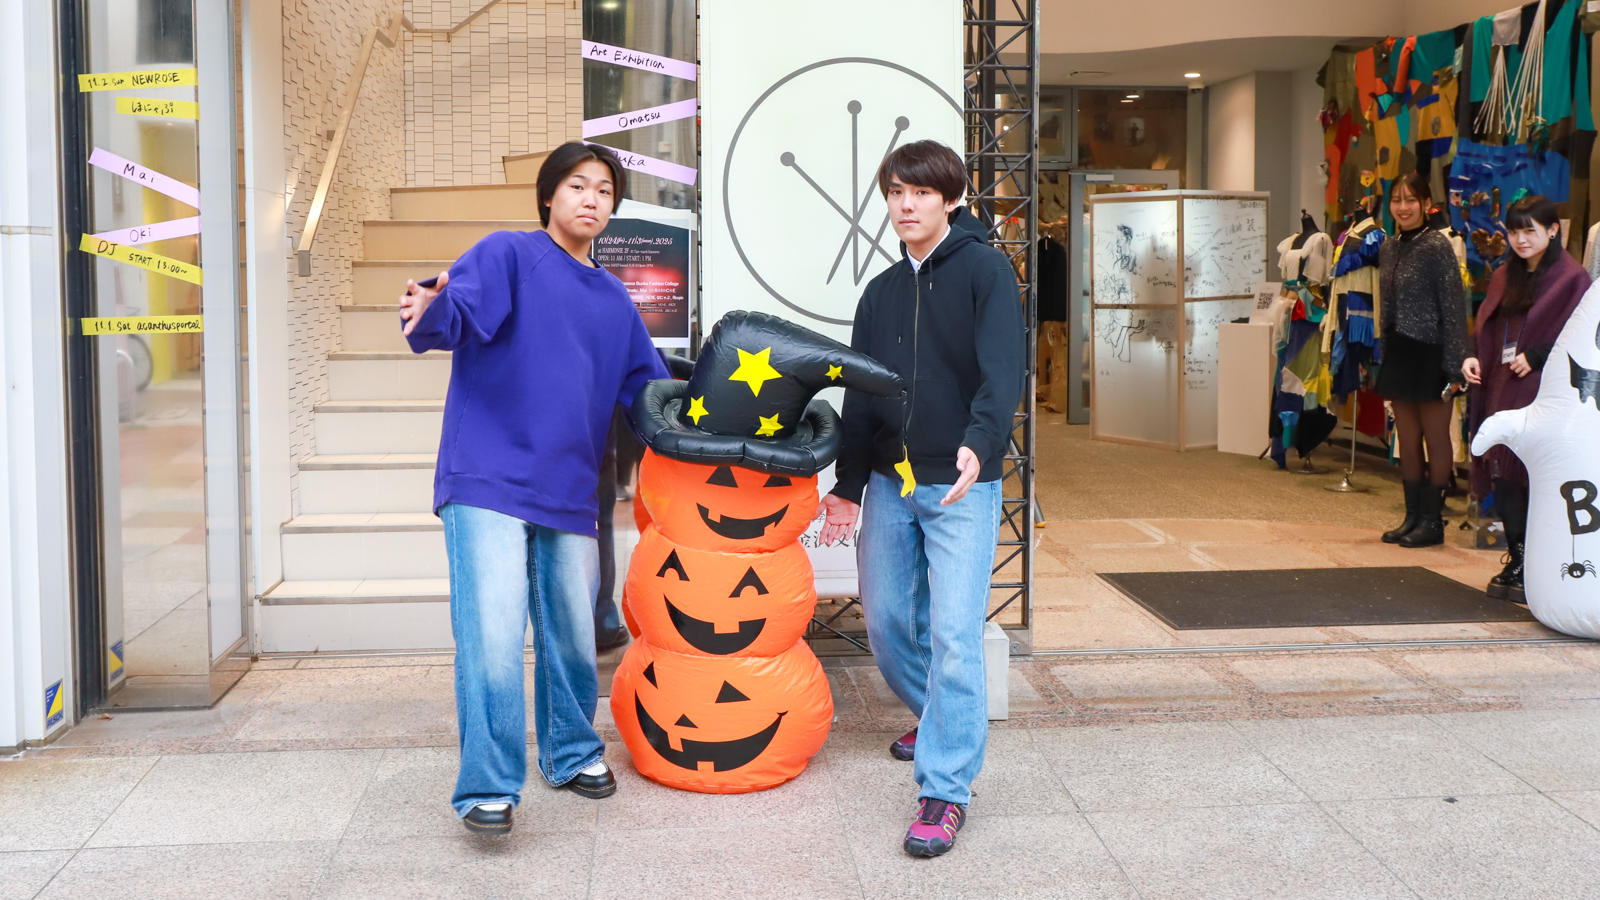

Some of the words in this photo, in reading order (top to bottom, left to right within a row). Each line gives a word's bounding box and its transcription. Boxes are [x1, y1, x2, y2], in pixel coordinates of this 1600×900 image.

[590, 45, 607, 56] Art
[614, 50, 665, 69] Exhibition
[132, 72, 180, 86] NEWROSE
[618, 111, 661, 128] Omatsu
[123, 163, 156, 183] Mai
[129, 227, 152, 243] Oki
[97, 240, 118, 256] DJ
[1560, 480, 1600, 535] B
